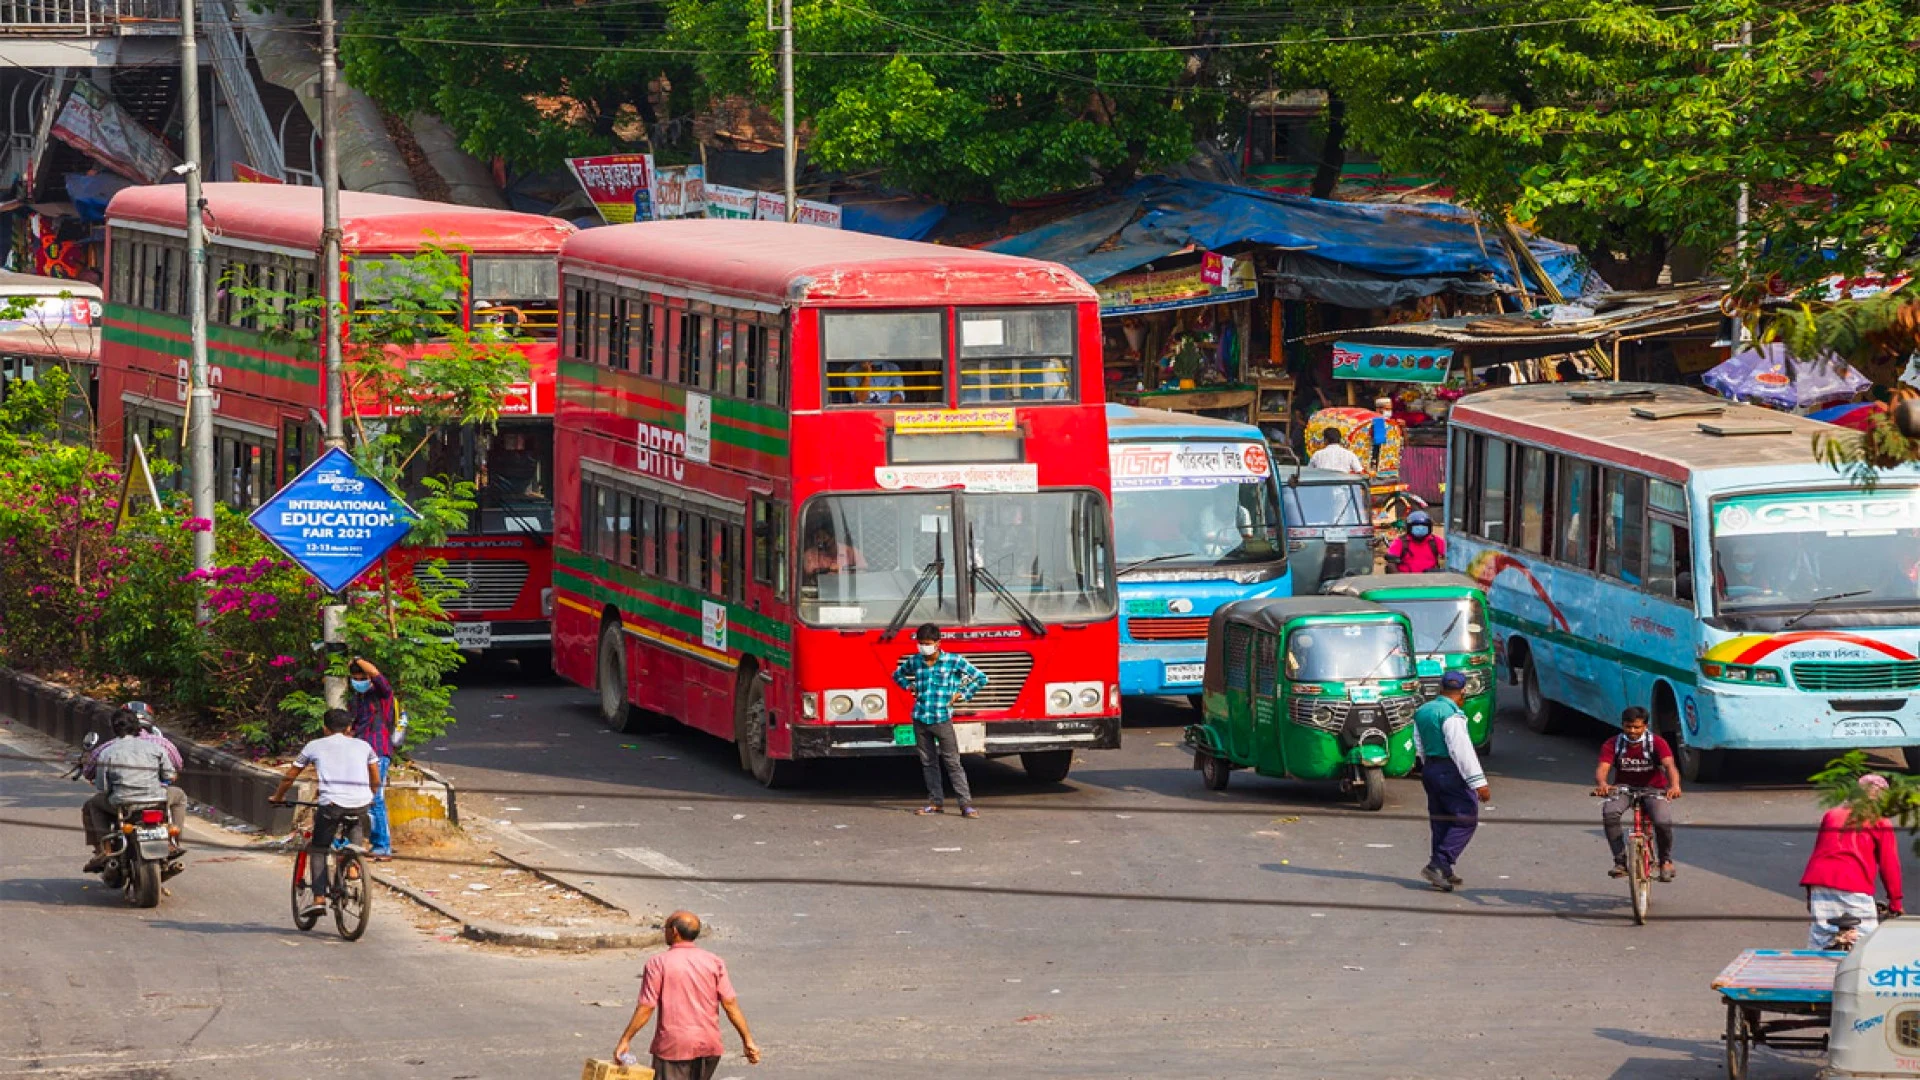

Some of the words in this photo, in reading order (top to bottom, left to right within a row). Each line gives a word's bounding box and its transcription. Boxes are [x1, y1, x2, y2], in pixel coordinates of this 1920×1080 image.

[638, 422, 684, 480] BRTC
[289, 500, 387, 510] INTERNATIONAL
[281, 513, 394, 527] EDUCATION
[302, 528, 334, 538] FAIR
[338, 528, 371, 539] 2021
[963, 630, 1022, 639] LEYLAND
